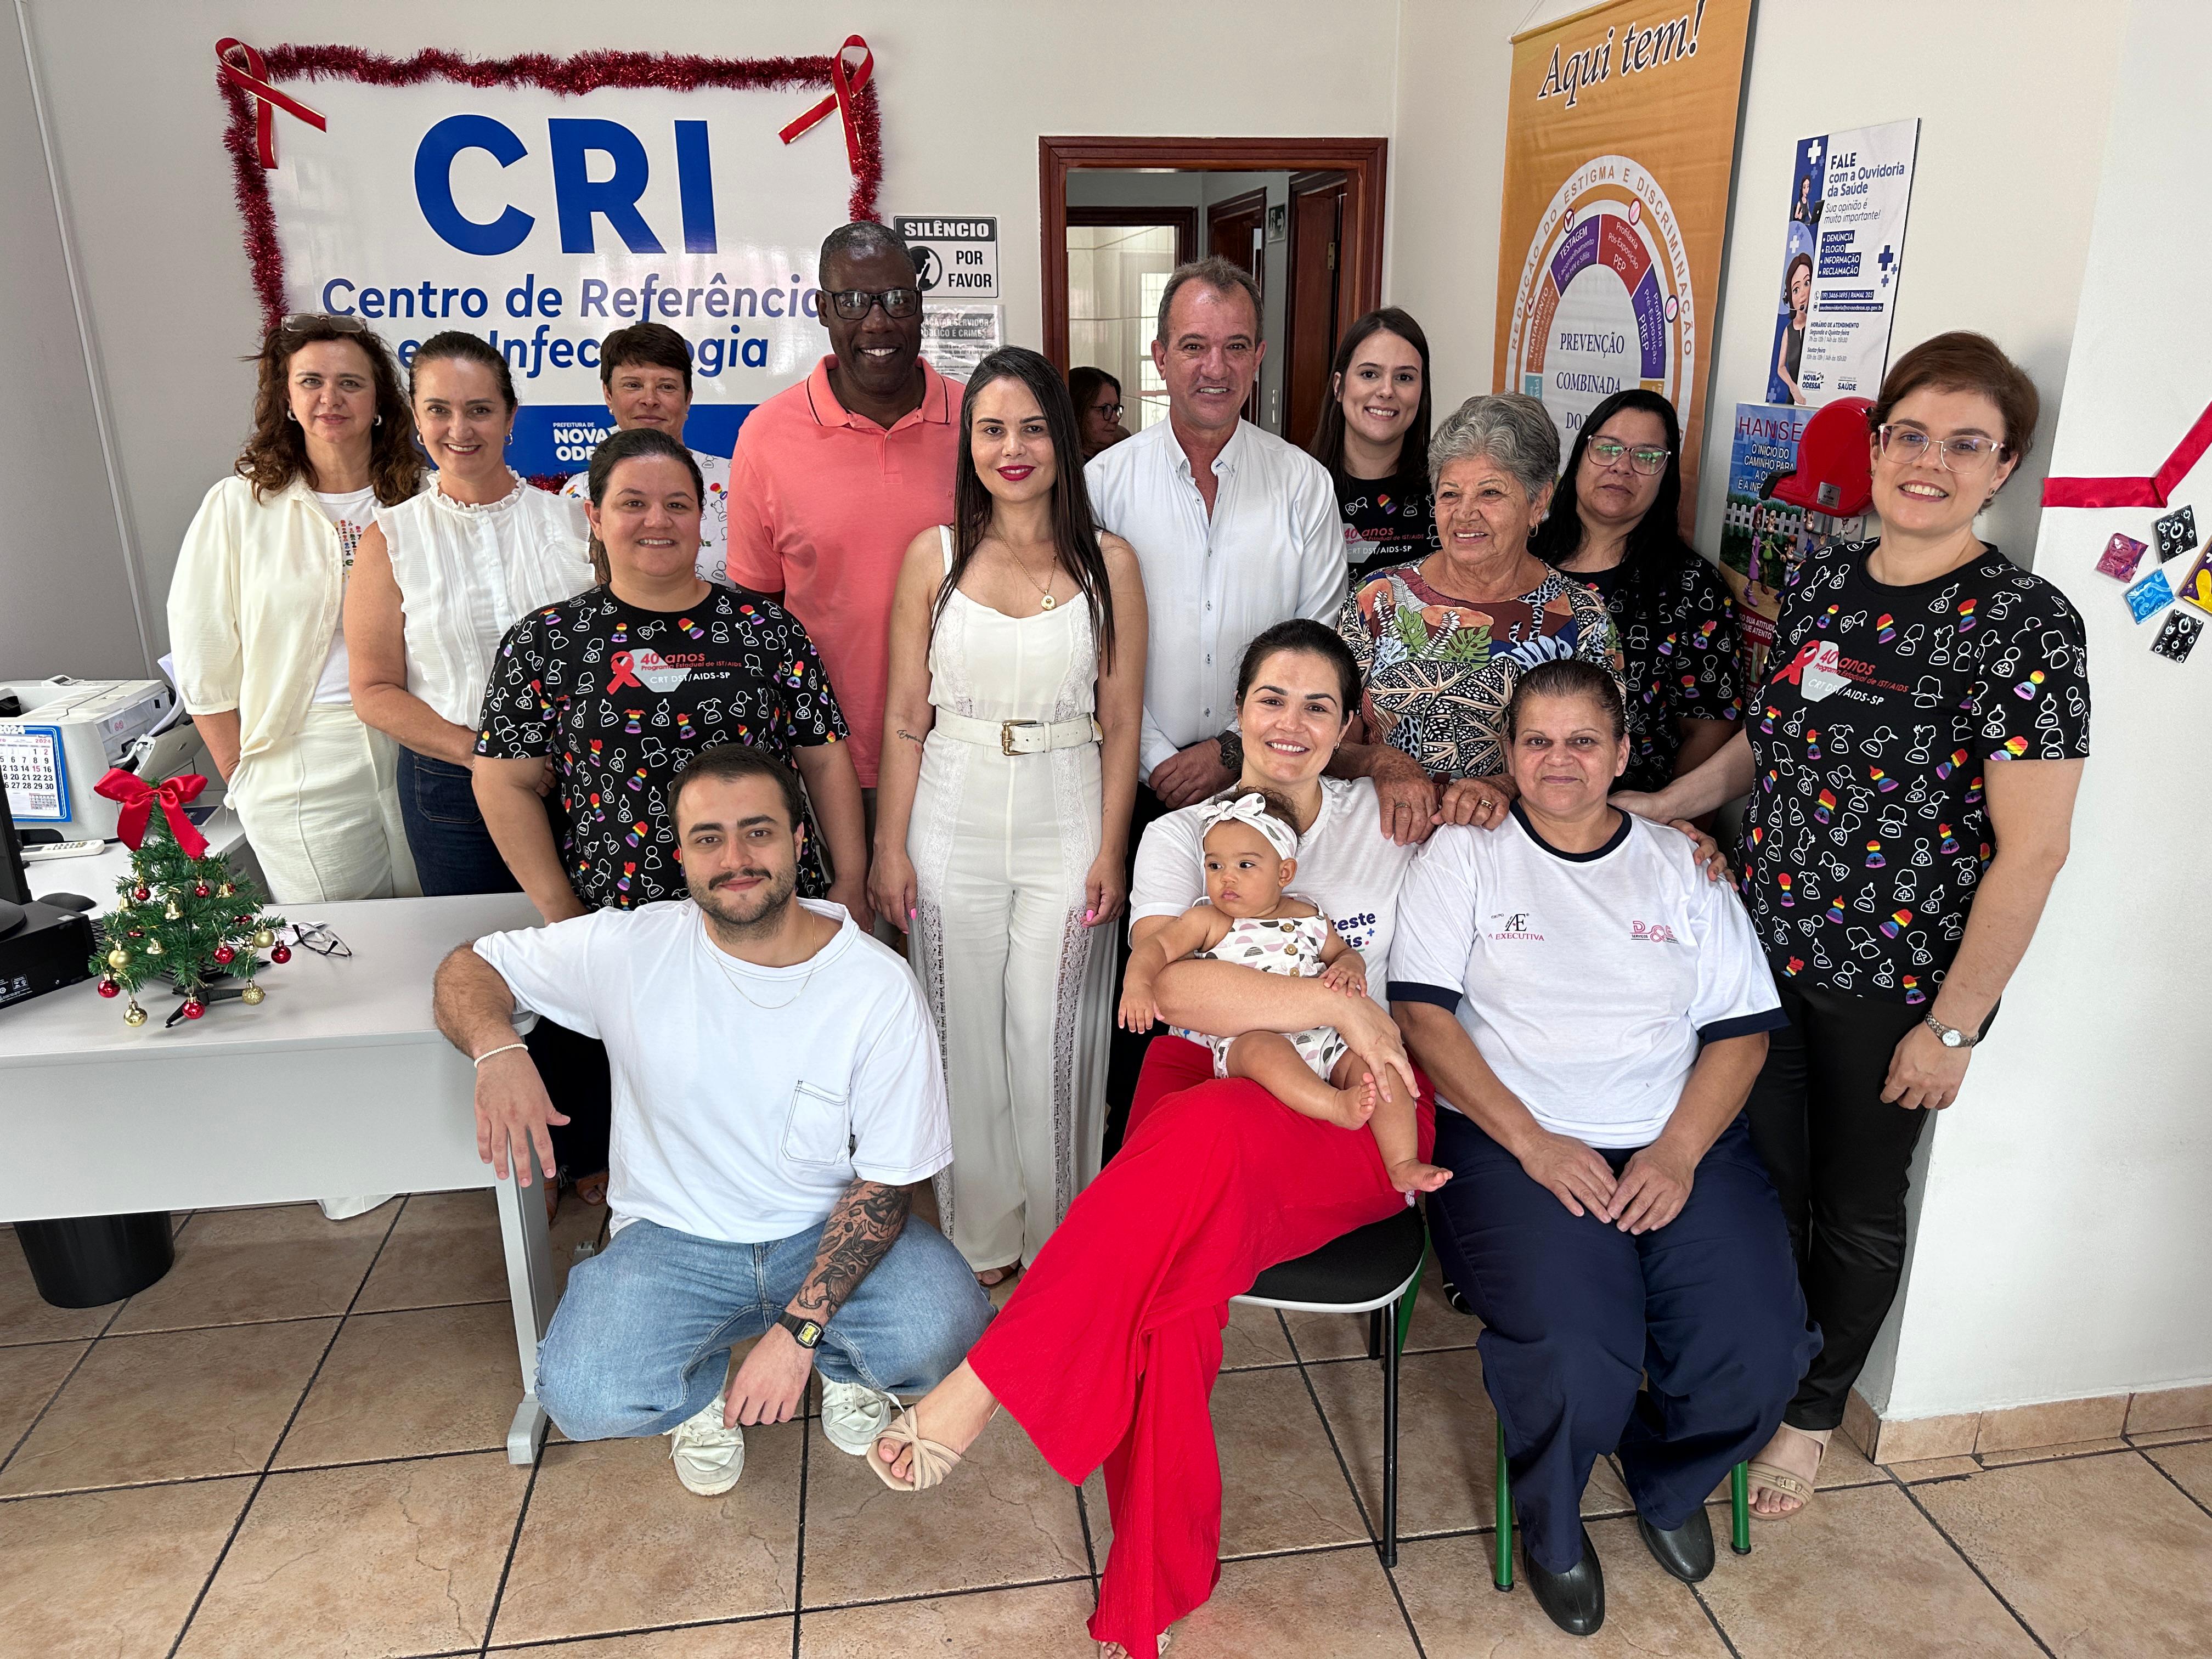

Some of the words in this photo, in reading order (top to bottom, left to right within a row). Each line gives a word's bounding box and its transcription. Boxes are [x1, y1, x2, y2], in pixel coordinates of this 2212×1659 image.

[1537, 26, 1615, 110] Aqui
[1620, 0, 1706, 77] tem!
[1830, 153, 1857, 170] FALE
[1829, 172, 1848, 183] com
[1850, 171, 1855, 182] a
[1858, 161, 1905, 180] Ouvidoria
[414, 114, 718, 256] CRI
[1827, 185, 1838, 198] da
[1839, 182, 1868, 196] Saúde
[1825, 202, 1837, 213] Sua
[1837, 199, 1861, 212] opinião
[1863, 198, 1868, 210] é
[1824, 213, 1842, 224] muito
[1842, 210, 1881, 224] importante!
[904, 220, 989, 237] SILÊNCIO
[1616, 222, 1638, 250] Profilaxia
[1826, 232, 1853, 242] DENÚNCIA
[1559, 225, 1588, 259] TESTAGEM
[1825, 245, 1845, 253] ELOGIO
[956, 250, 983, 264] POR
[1608, 232, 1639, 270] Pós-Exposição
[1824, 254, 1860, 265] INFORMAÇÃO
[1511, 245, 1539, 351] REDUÇÃO
[1543, 209, 1557, 236] DO
[1564, 165, 1615, 204] ESTIGMA
[1623, 168, 1630, 183] E
[1637, 177, 1694, 356] DISCRIMINAÇÃO
[1613, 253, 1626, 272] PEP
[1822, 265, 1859, 276] RECLAMAÇÃO
[948, 273, 992, 287] FAVOR
[322, 278, 488, 318] Centro
[506, 274, 562, 318] de
[1529, 287, 1549, 359] TRATAMENTO
[1644, 289, 1657, 365] Pré-Exposição
[1653, 292, 1663, 347] Profilaxia
[1638, 313, 1649, 351] PREP
[1559, 332, 1624, 359] PREVENÇÃO
[490, 330, 768, 379] nfecgia
[1556, 371, 1621, 395] COMBINADA
[1802, 381, 1821, 390] ODESSA
[1837, 382, 1857, 391] SAÚDE
[1565, 412, 1582, 431] DO
[1739, 416, 1803, 442] HANSE
[554, 428, 608, 444] NOVA
[556, 445, 596, 461] ODE
[1751, 443, 1757, 454] O
[1758, 443, 1778, 458] INÍCIO
[1779, 448, 1790, 459] DO
[1743, 455, 1775, 470] CAMINHO
[1776, 460, 1794, 470] PARA
[1754, 470, 1760, 480] A
[1738, 478, 1743, 489] É
[1743, 481, 1748, 490] A
[1345, 528, 1358, 539] 40
[1361, 527, 1394, 537] anos
[1363, 545, 1412, 555] DST/AIDS-SP
[1746, 615, 1756, 627] SUA
[1740, 623, 1752, 633] QUE
[1752, 627, 1772, 640] ATENTO
[640, 653, 659, 665] 40
[665, 653, 706, 664] anos
[1819, 649, 1840, 665] 40
[1838, 657, 1876, 676] anos
[650, 676, 668, 684] CRT
[671, 672, 731, 682] DST/AIDS-SP
[1813, 663, 1840, 675] Programa
[1841, 669, 1867, 682] Estadual
[1866, 676, 1877, 685] de
[1877, 680, 1909, 693] IST/AIDS
[1808, 679, 1824, 690] CRT
[1825, 682, 1884, 706] DST/AIDS-SP
[1496, 933, 1544, 941] EXECUTIVA
